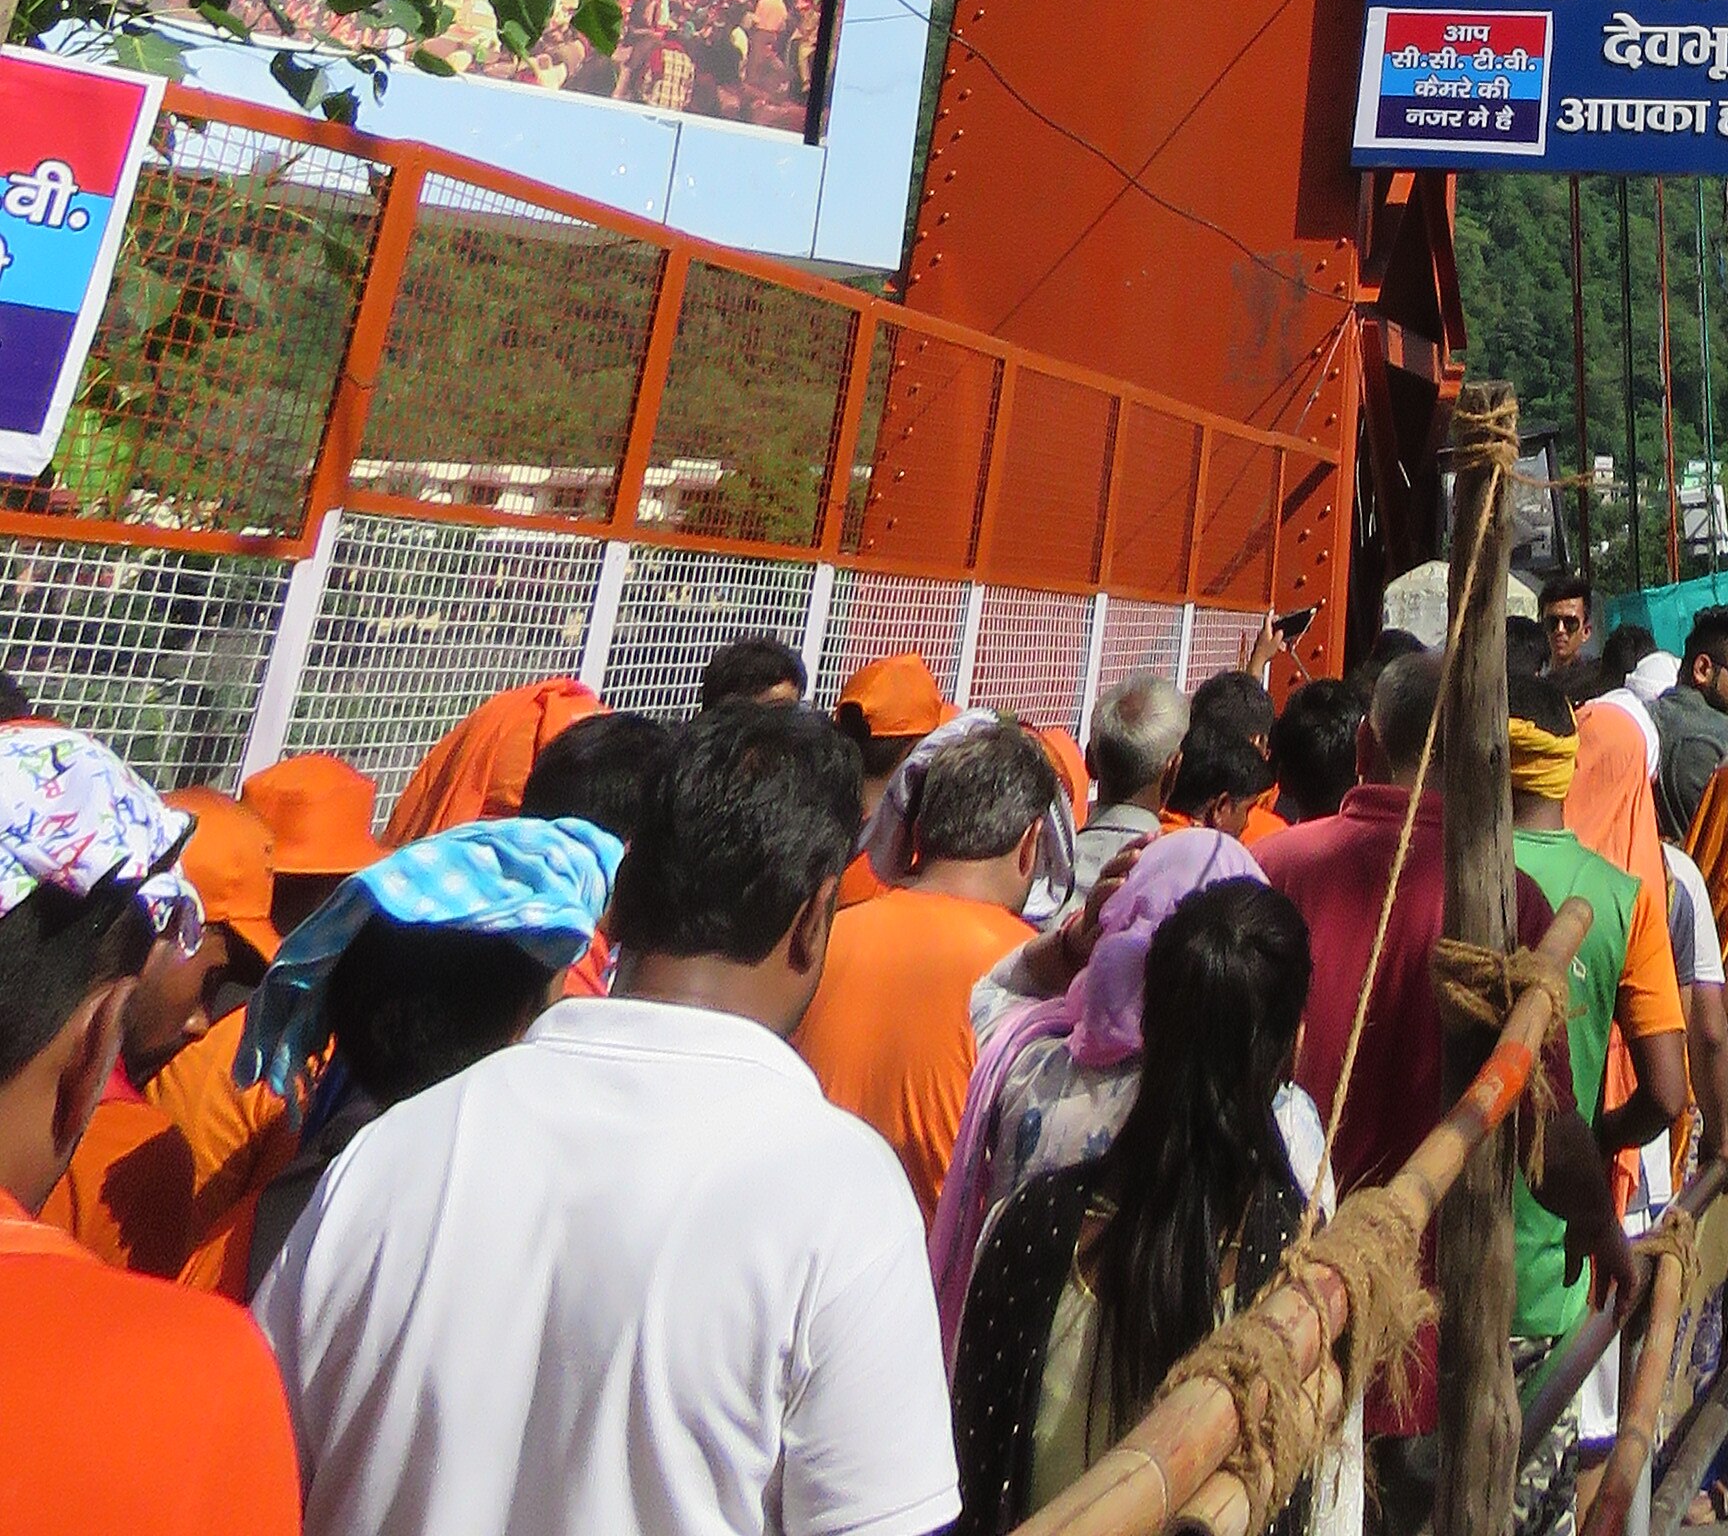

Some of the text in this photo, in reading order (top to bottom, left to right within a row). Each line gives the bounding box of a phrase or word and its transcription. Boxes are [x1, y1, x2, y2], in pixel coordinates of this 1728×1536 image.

[1443, 24, 1492, 42] आप
[1414, 74, 1512, 100] कैमरे की
[1405, 108, 1465, 128] नजर
[1555, 97, 1711, 133] आपका
